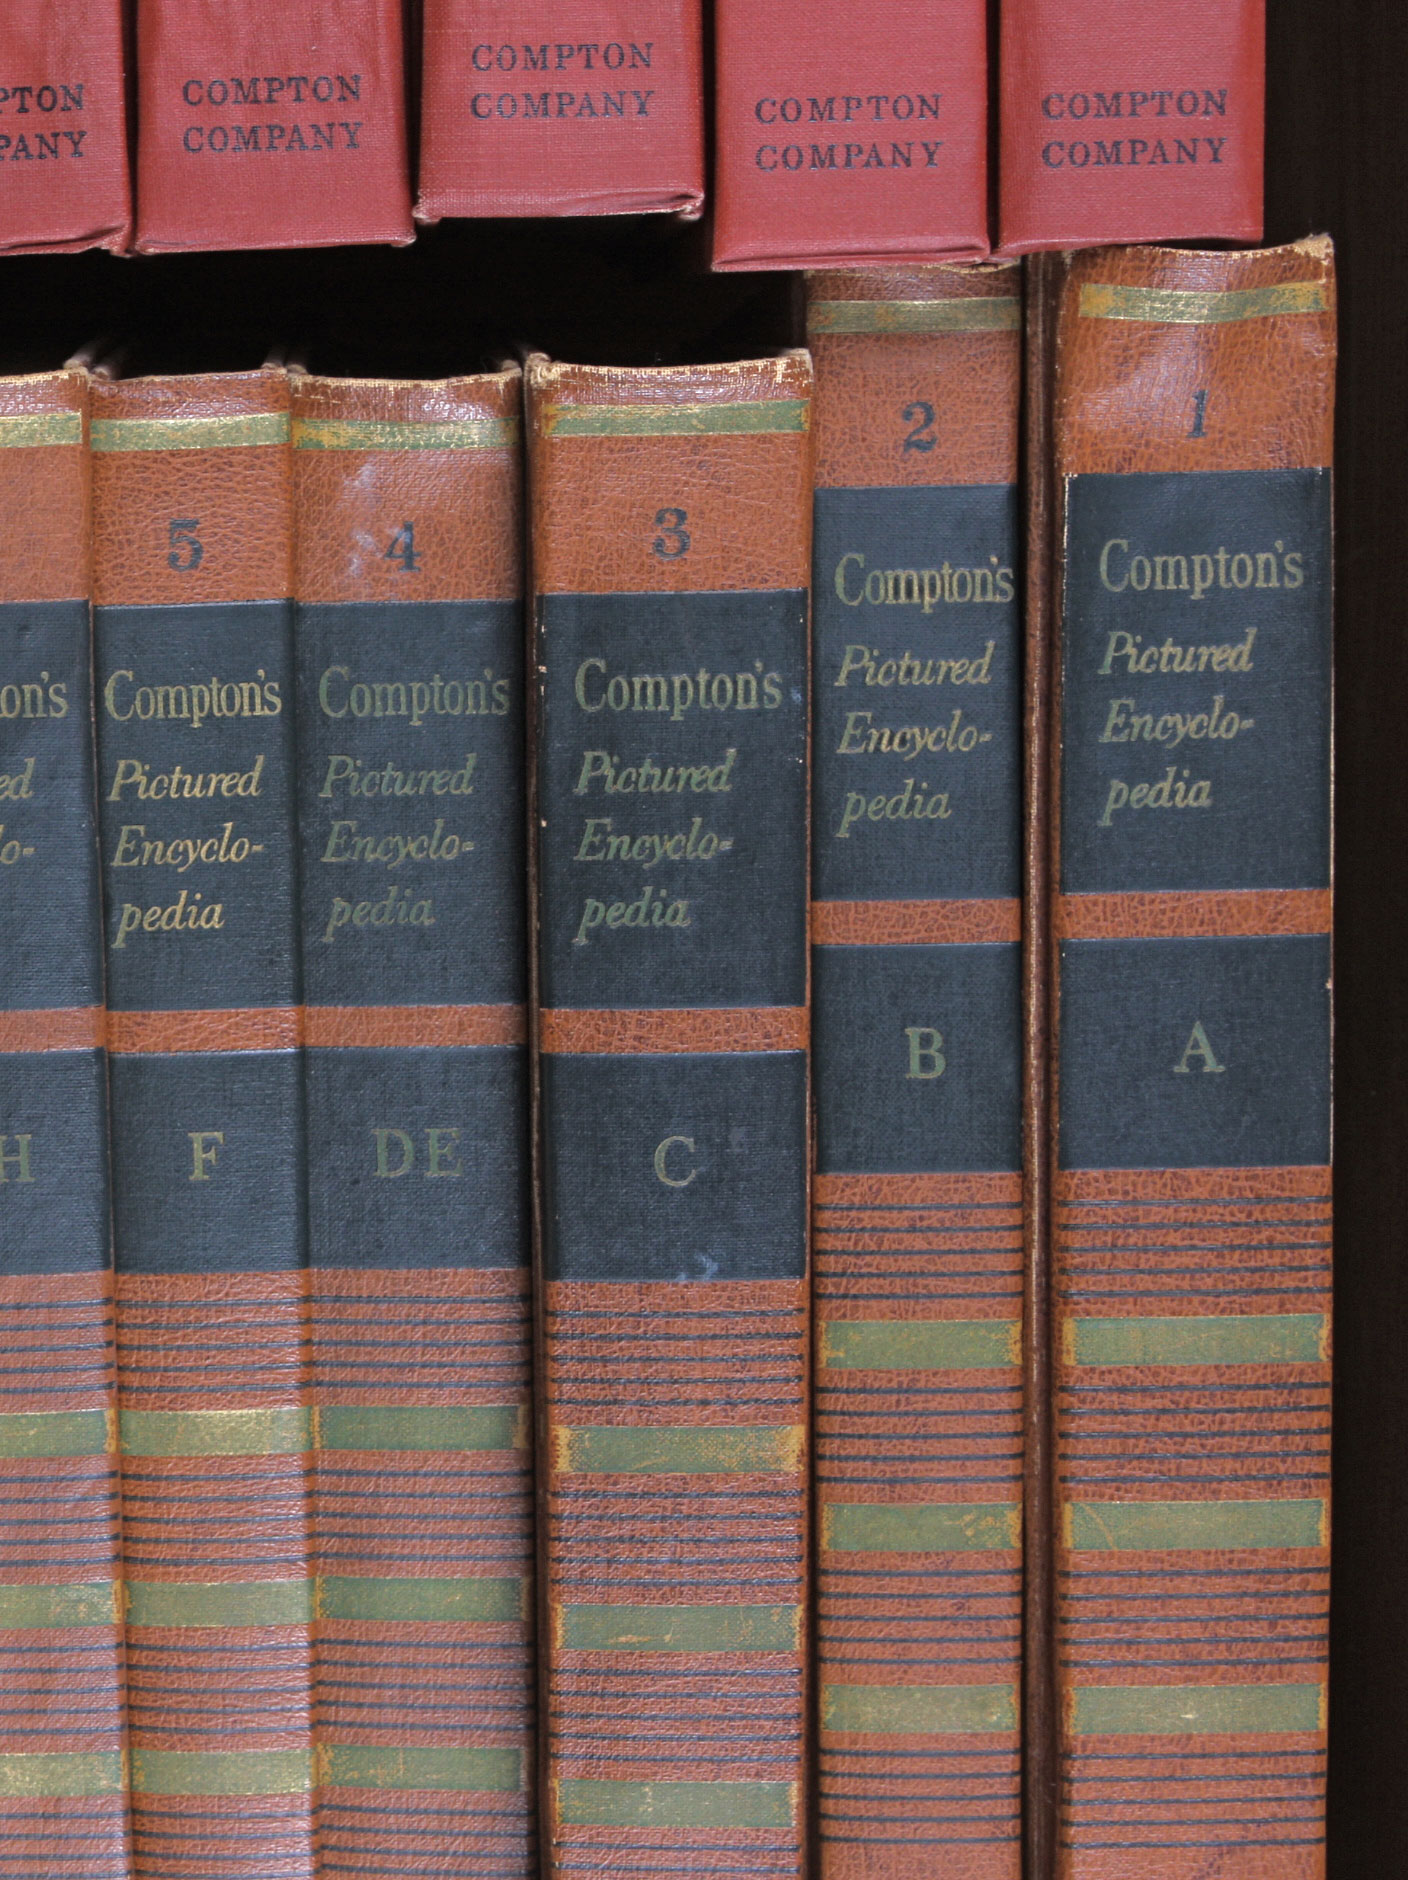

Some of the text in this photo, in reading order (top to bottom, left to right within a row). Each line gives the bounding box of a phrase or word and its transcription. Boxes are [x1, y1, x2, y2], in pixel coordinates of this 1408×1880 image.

[472, 42, 654, 71] COMPTON
[181, 74, 361, 107] COMPTON
[470, 90, 655, 119] COMPANY
[754, 93, 942, 124] COMPTON
[1041, 89, 1228, 120] COMPTON
[182, 121, 363, 154] COMPANY
[755, 141, 944, 172] COMPANY
[1041, 137, 1229, 169] COMPANY
[902, 401, 938, 453] 2
[1186, 389, 1208, 439] 1
[167, 518, 203, 572] 5
[384, 522, 421, 573] 4
[653, 508, 691, 561] 3
[834, 553, 1014, 613] Compton's
[1099, 539, 1303, 600] Compton's
[835, 640, 995, 687] Pictured
[1098, 628, 1257, 675] Pictured
[105, 669, 282, 728] Compton's
[319, 665, 510, 726] Compton's
[574, 658, 782, 720] Compton's
[836, 710, 993, 760] Encyclo-
[1099, 695, 1254, 745] Encyclo-
[108, 754, 264, 801] Pictured
[319, 753, 475, 798] Pictured
[574, 749, 737, 795] Pictured
[1098, 767, 1213, 827] pedia
[836, 780, 951, 838] pedia
[111, 822, 263, 873] Encyclo-
[322, 819, 474, 869] Encyclo-
[574, 818, 732, 868] Encyclo-
[112, 891, 225, 948] pedia
[322, 887, 434, 942] pedia
[573, 887, 690, 945] pedia
[905, 1027, 945, 1079] B
[1174, 1021, 1225, 1073] A
[188, 1132, 223, 1182] F
[653, 1136, 696, 1187] C
